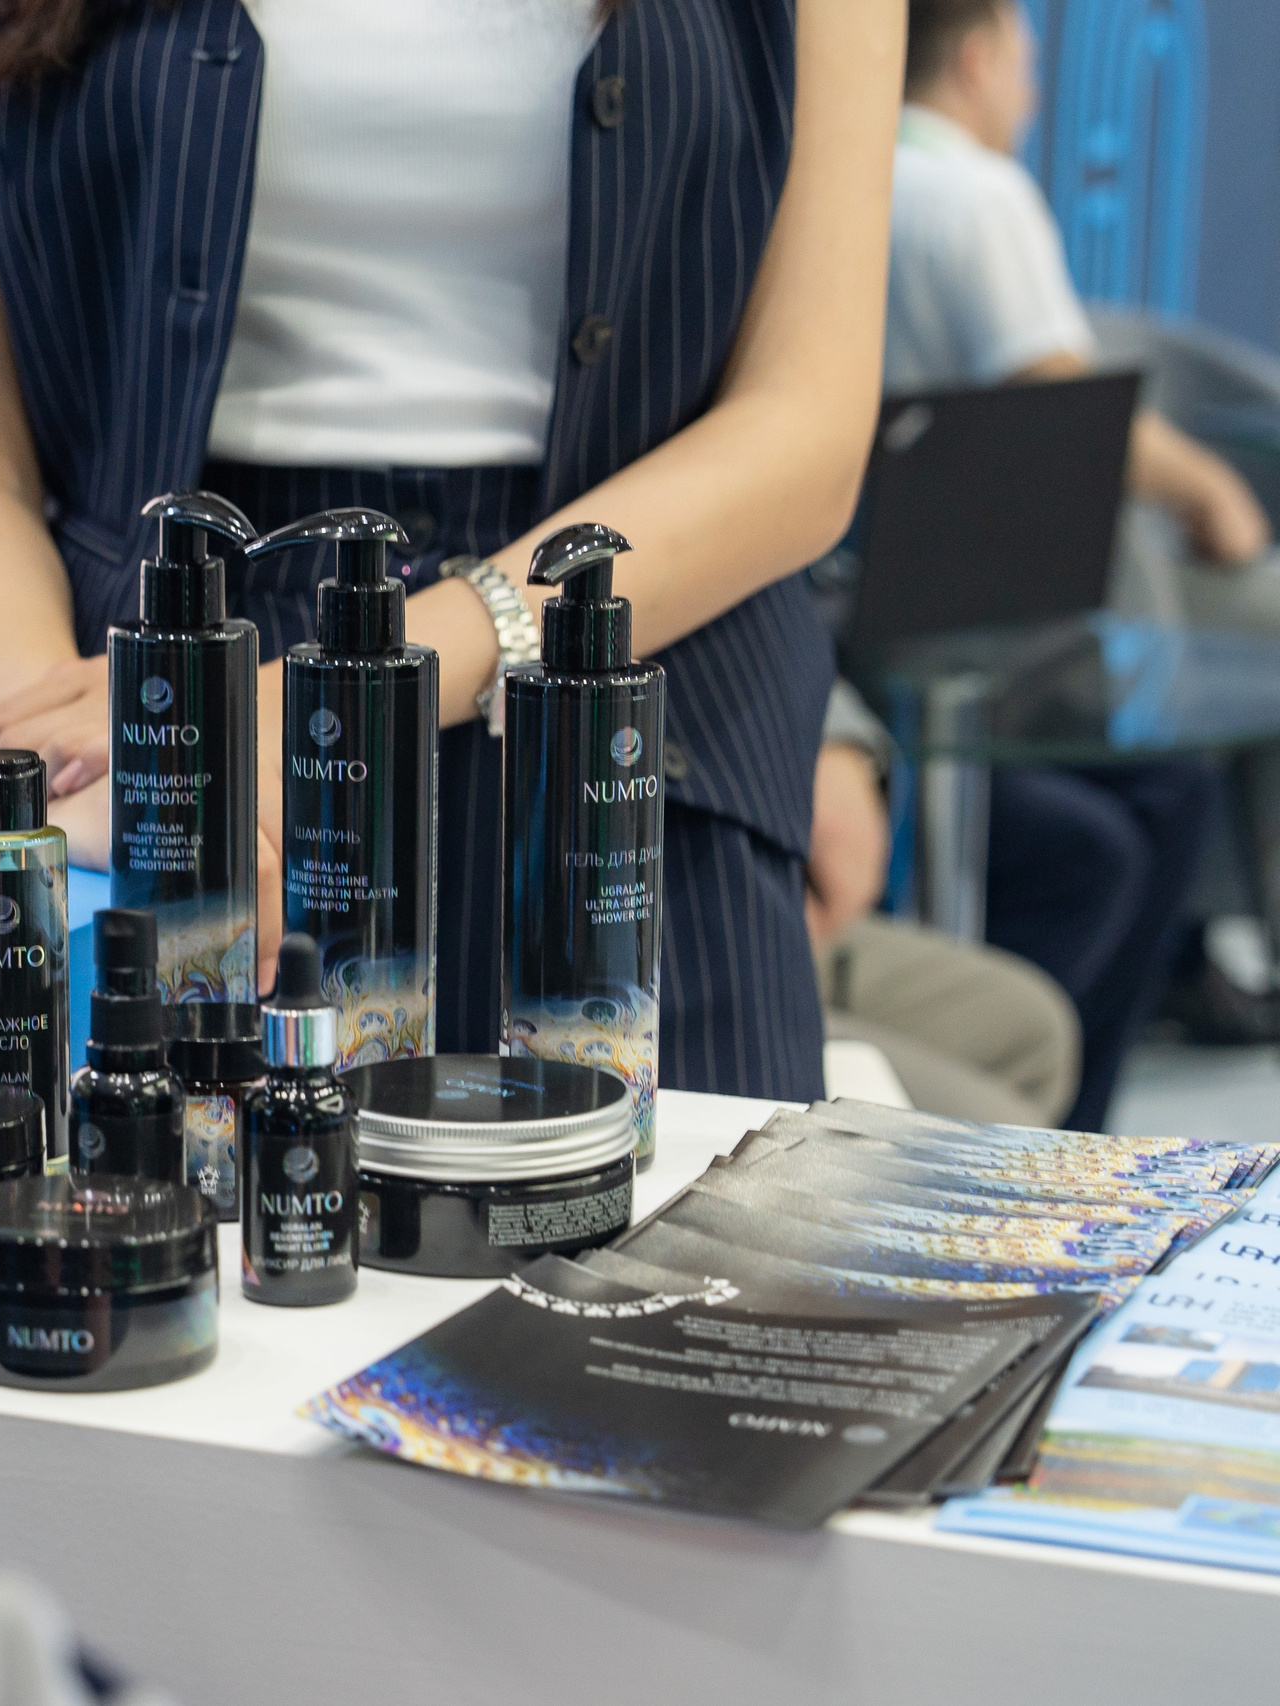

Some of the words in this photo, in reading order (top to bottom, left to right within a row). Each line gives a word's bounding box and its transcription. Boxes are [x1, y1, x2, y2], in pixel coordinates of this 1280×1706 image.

[122, 721, 200, 746] NUMTO
[291, 755, 368, 783] NUMTO
[116, 769, 213, 790] КОНДИЦИОНЕР
[123, 788, 149, 805] ДЛЯ
[150, 790, 199, 806] ВОЛОС
[583, 774, 658, 804] NUMTO
[136, 822, 184, 834] UGRALAN
[295, 824, 361, 844] ШАМПУНЬ
[155, 832, 204, 847] COMPLEX
[153, 847, 198, 859] KERATIN
[565, 852, 605, 868] ГЕЛЬ
[607, 848, 637, 870] ДЛЯ
[638, 843, 661, 866] ДУШ
[129, 857, 196, 872] CONDITIONER
[303, 858, 349, 874] UGRALAN
[309, 884, 352, 901] KERATIN
[354, 886, 399, 901] ELASTIN
[600, 881, 646, 897] UGRALAN
[302, 897, 350, 913] SHAMPOO
[585, 891, 654, 912] ULTRA-GENTLE
[591, 909, 635, 925] SHOWER
[636, 907, 651, 921] GEL
[260, 1189, 343, 1216] NUMTO
[6, 1324, 95, 1355] NUMTO
